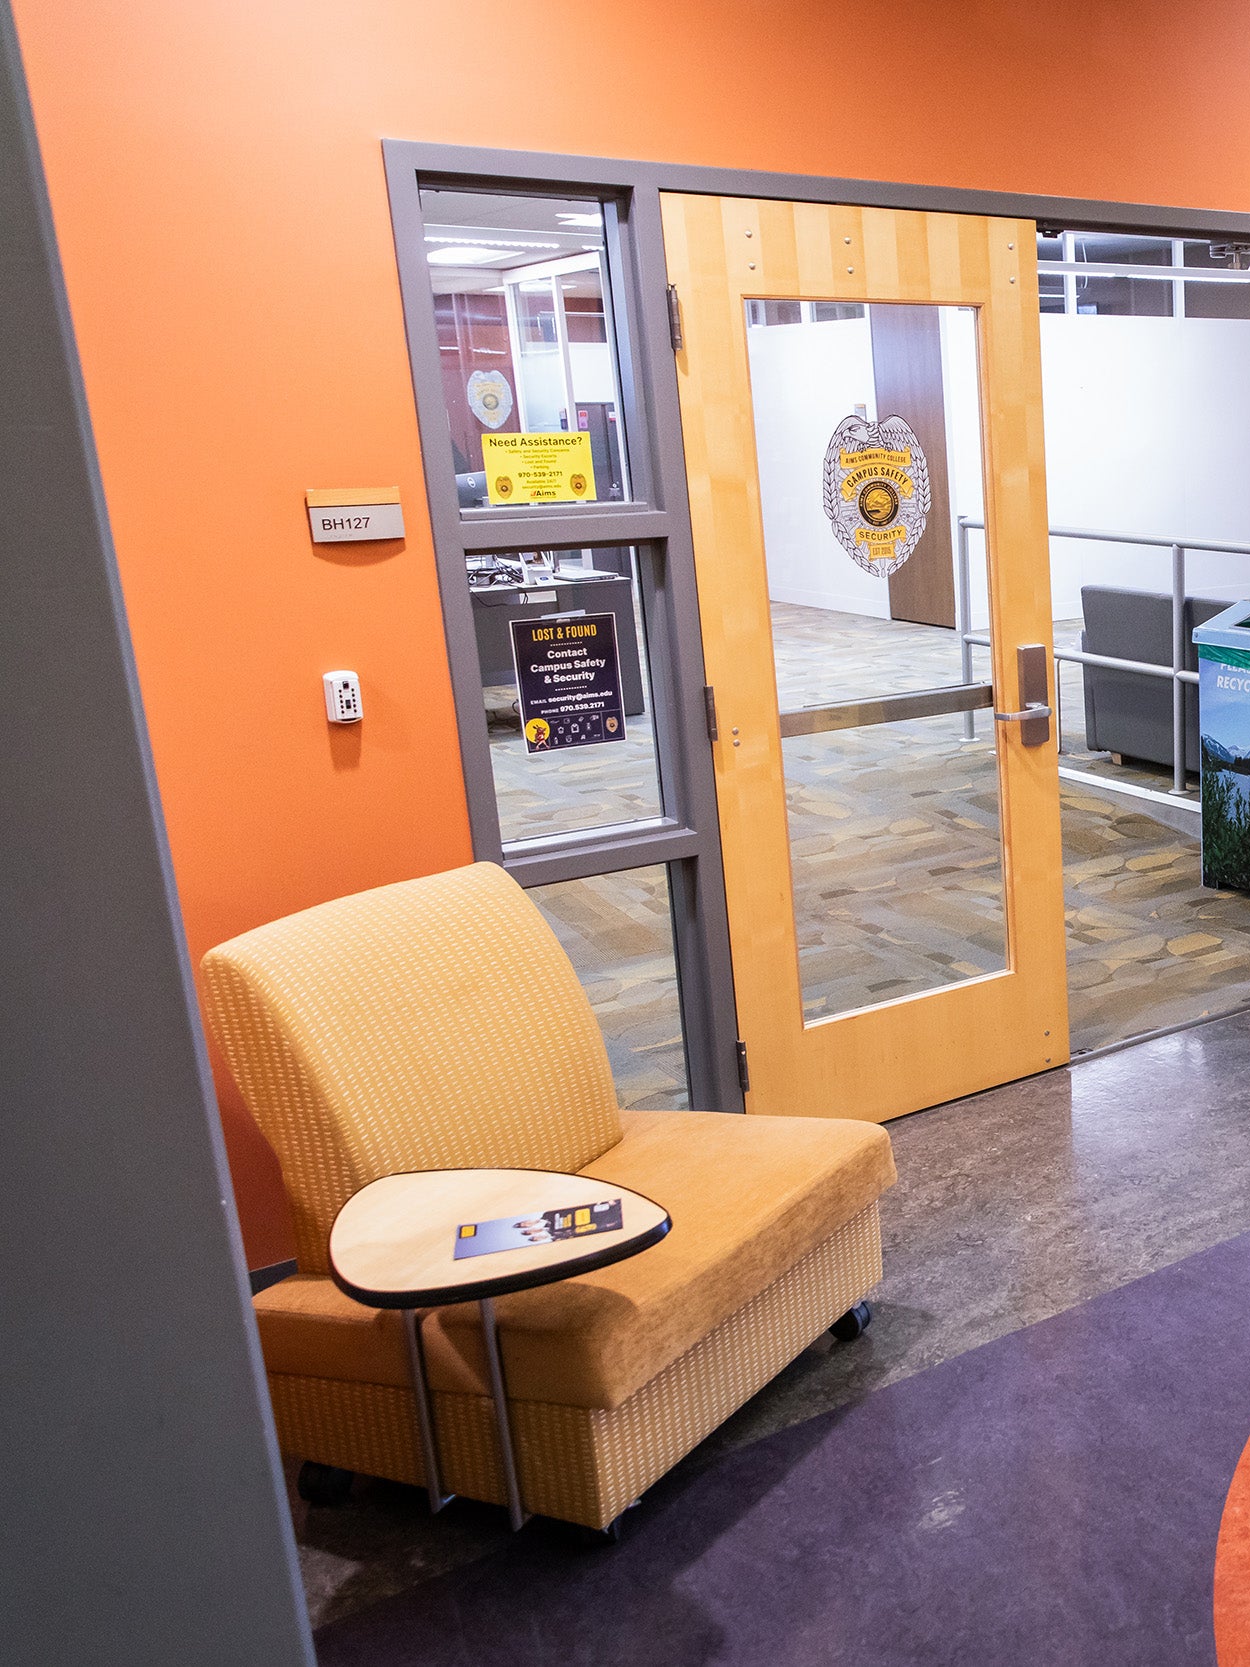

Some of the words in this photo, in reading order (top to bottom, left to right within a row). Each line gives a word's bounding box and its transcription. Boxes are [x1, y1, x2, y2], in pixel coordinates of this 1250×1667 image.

[489, 438, 517, 447] Need
[520, 437, 583, 447] Assistance?
[846, 456, 858, 464] AIMS
[858, 452, 886, 463] COMMUNITY
[887, 454, 907, 464] COLLEGE
[846, 466, 879, 488] CAMPUS
[880, 466, 909, 485] SAFETY
[321, 517, 371, 531] BH127
[859, 530, 902, 541] SECURITY
[532, 627, 554, 641] LOST
[556, 627, 564, 639] &
[565, 624, 597, 638] FOUND
[547, 648, 587, 659] Contact
[530, 661, 573, 674] Campus
[573, 658, 606, 670] Safety
[544, 674, 552, 684] &
[553, 671, 596, 684] Security
[548, 690, 613, 703] security@aims.edu
[560, 701, 605, 713] 970.539.2171
